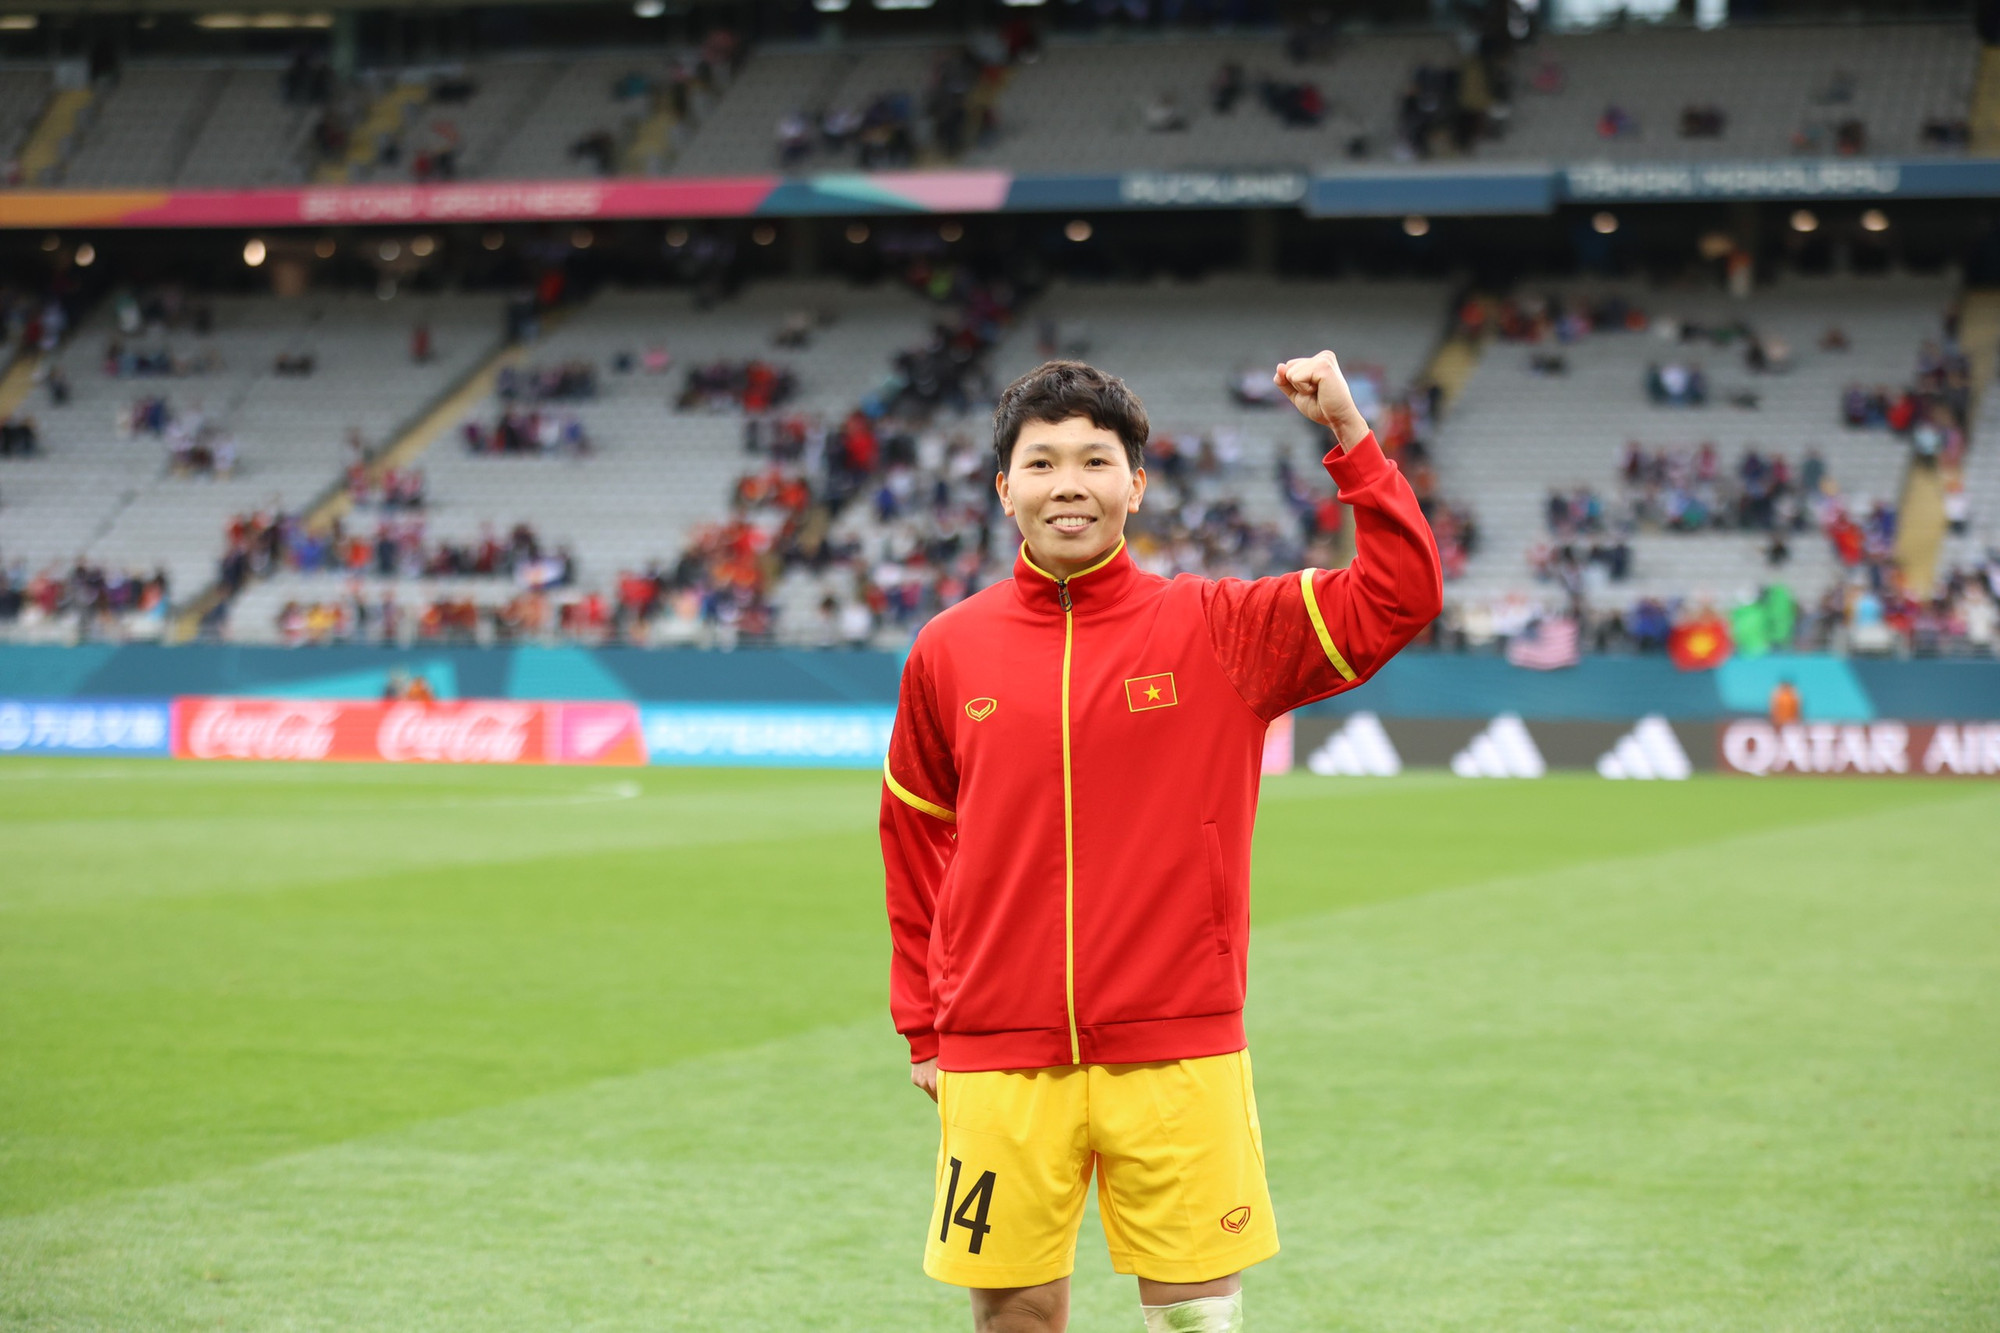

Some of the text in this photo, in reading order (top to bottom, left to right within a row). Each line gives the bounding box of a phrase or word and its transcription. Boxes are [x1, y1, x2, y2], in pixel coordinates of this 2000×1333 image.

[424, 185, 601, 217] GREATNESS
[1121, 173, 1307, 203] AUCKLAND
[188, 699, 342, 761] Coca-Cola
[377, 702, 537, 763] Coca-Cola
[1723, 718, 1909, 776] QATAR
[940, 1156, 996, 1255] 14
